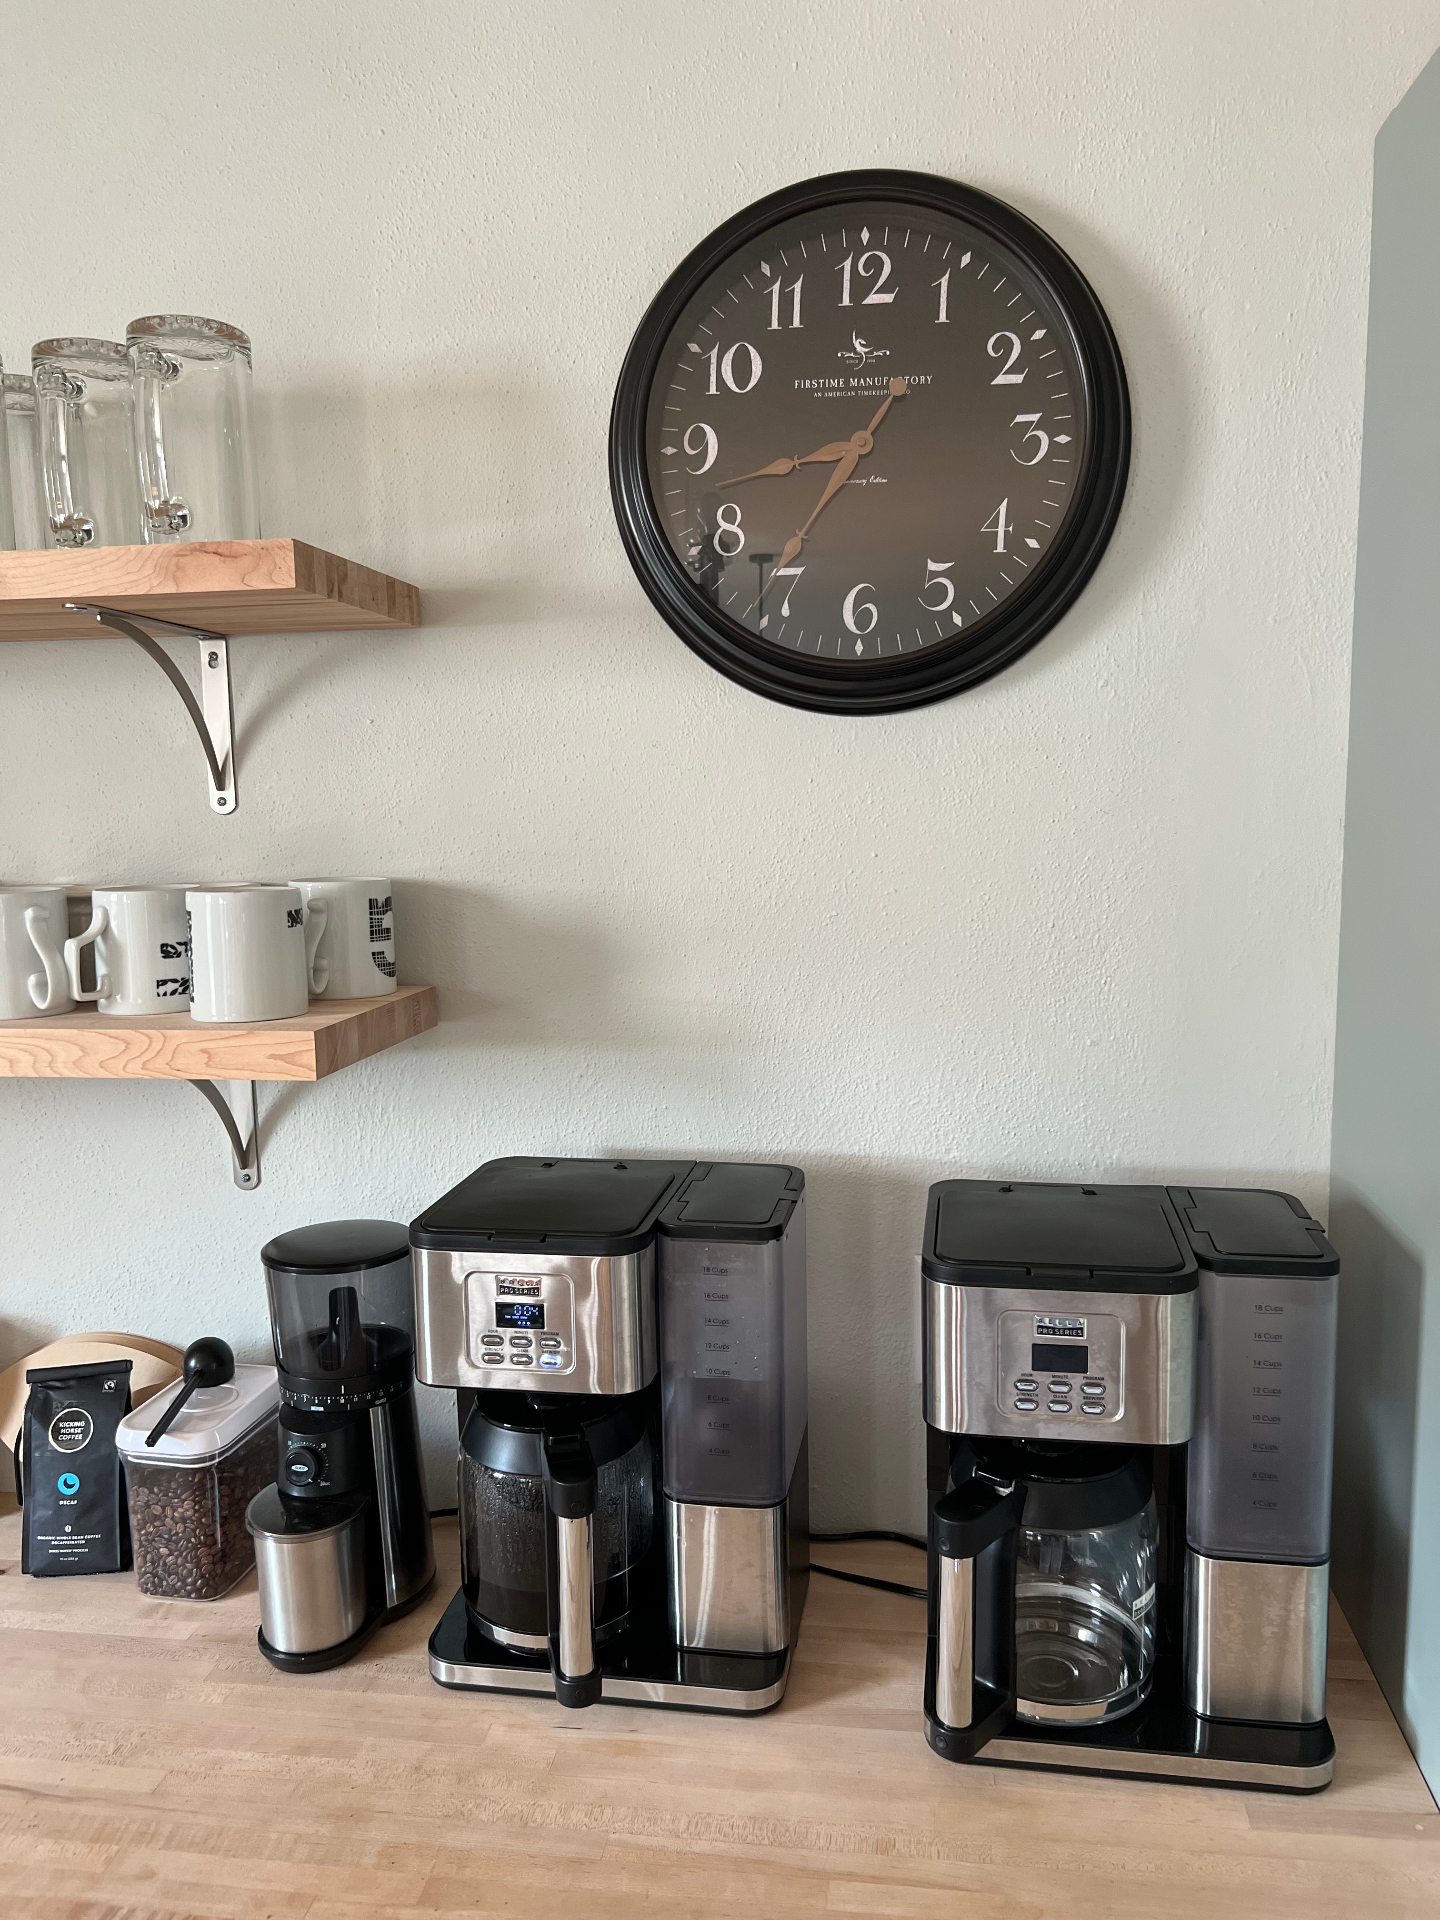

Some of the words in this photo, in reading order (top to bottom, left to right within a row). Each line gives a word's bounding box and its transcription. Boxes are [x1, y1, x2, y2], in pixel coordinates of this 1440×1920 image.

[764, 274, 804, 330] 11
[834, 250, 900, 307] 12
[931, 268, 952, 324] 1
[702, 342, 763, 395] 10
[794, 378, 845, 389] FIRSTIME
[849, 376, 933, 387] MANUFTORY
[988, 332, 1028, 386] 2
[683, 422, 719, 476] 9
[1009, 412, 1049, 466] 3
[870, 475, 888, 483] Edition
[713, 503, 745, 556] 8
[980, 497, 1013, 552] 4
[768, 566, 806, 618] 7
[842, 583, 878, 634] 6
[918, 558, 955, 612] 5
[1038, 1318, 1082, 1326] BELLA
